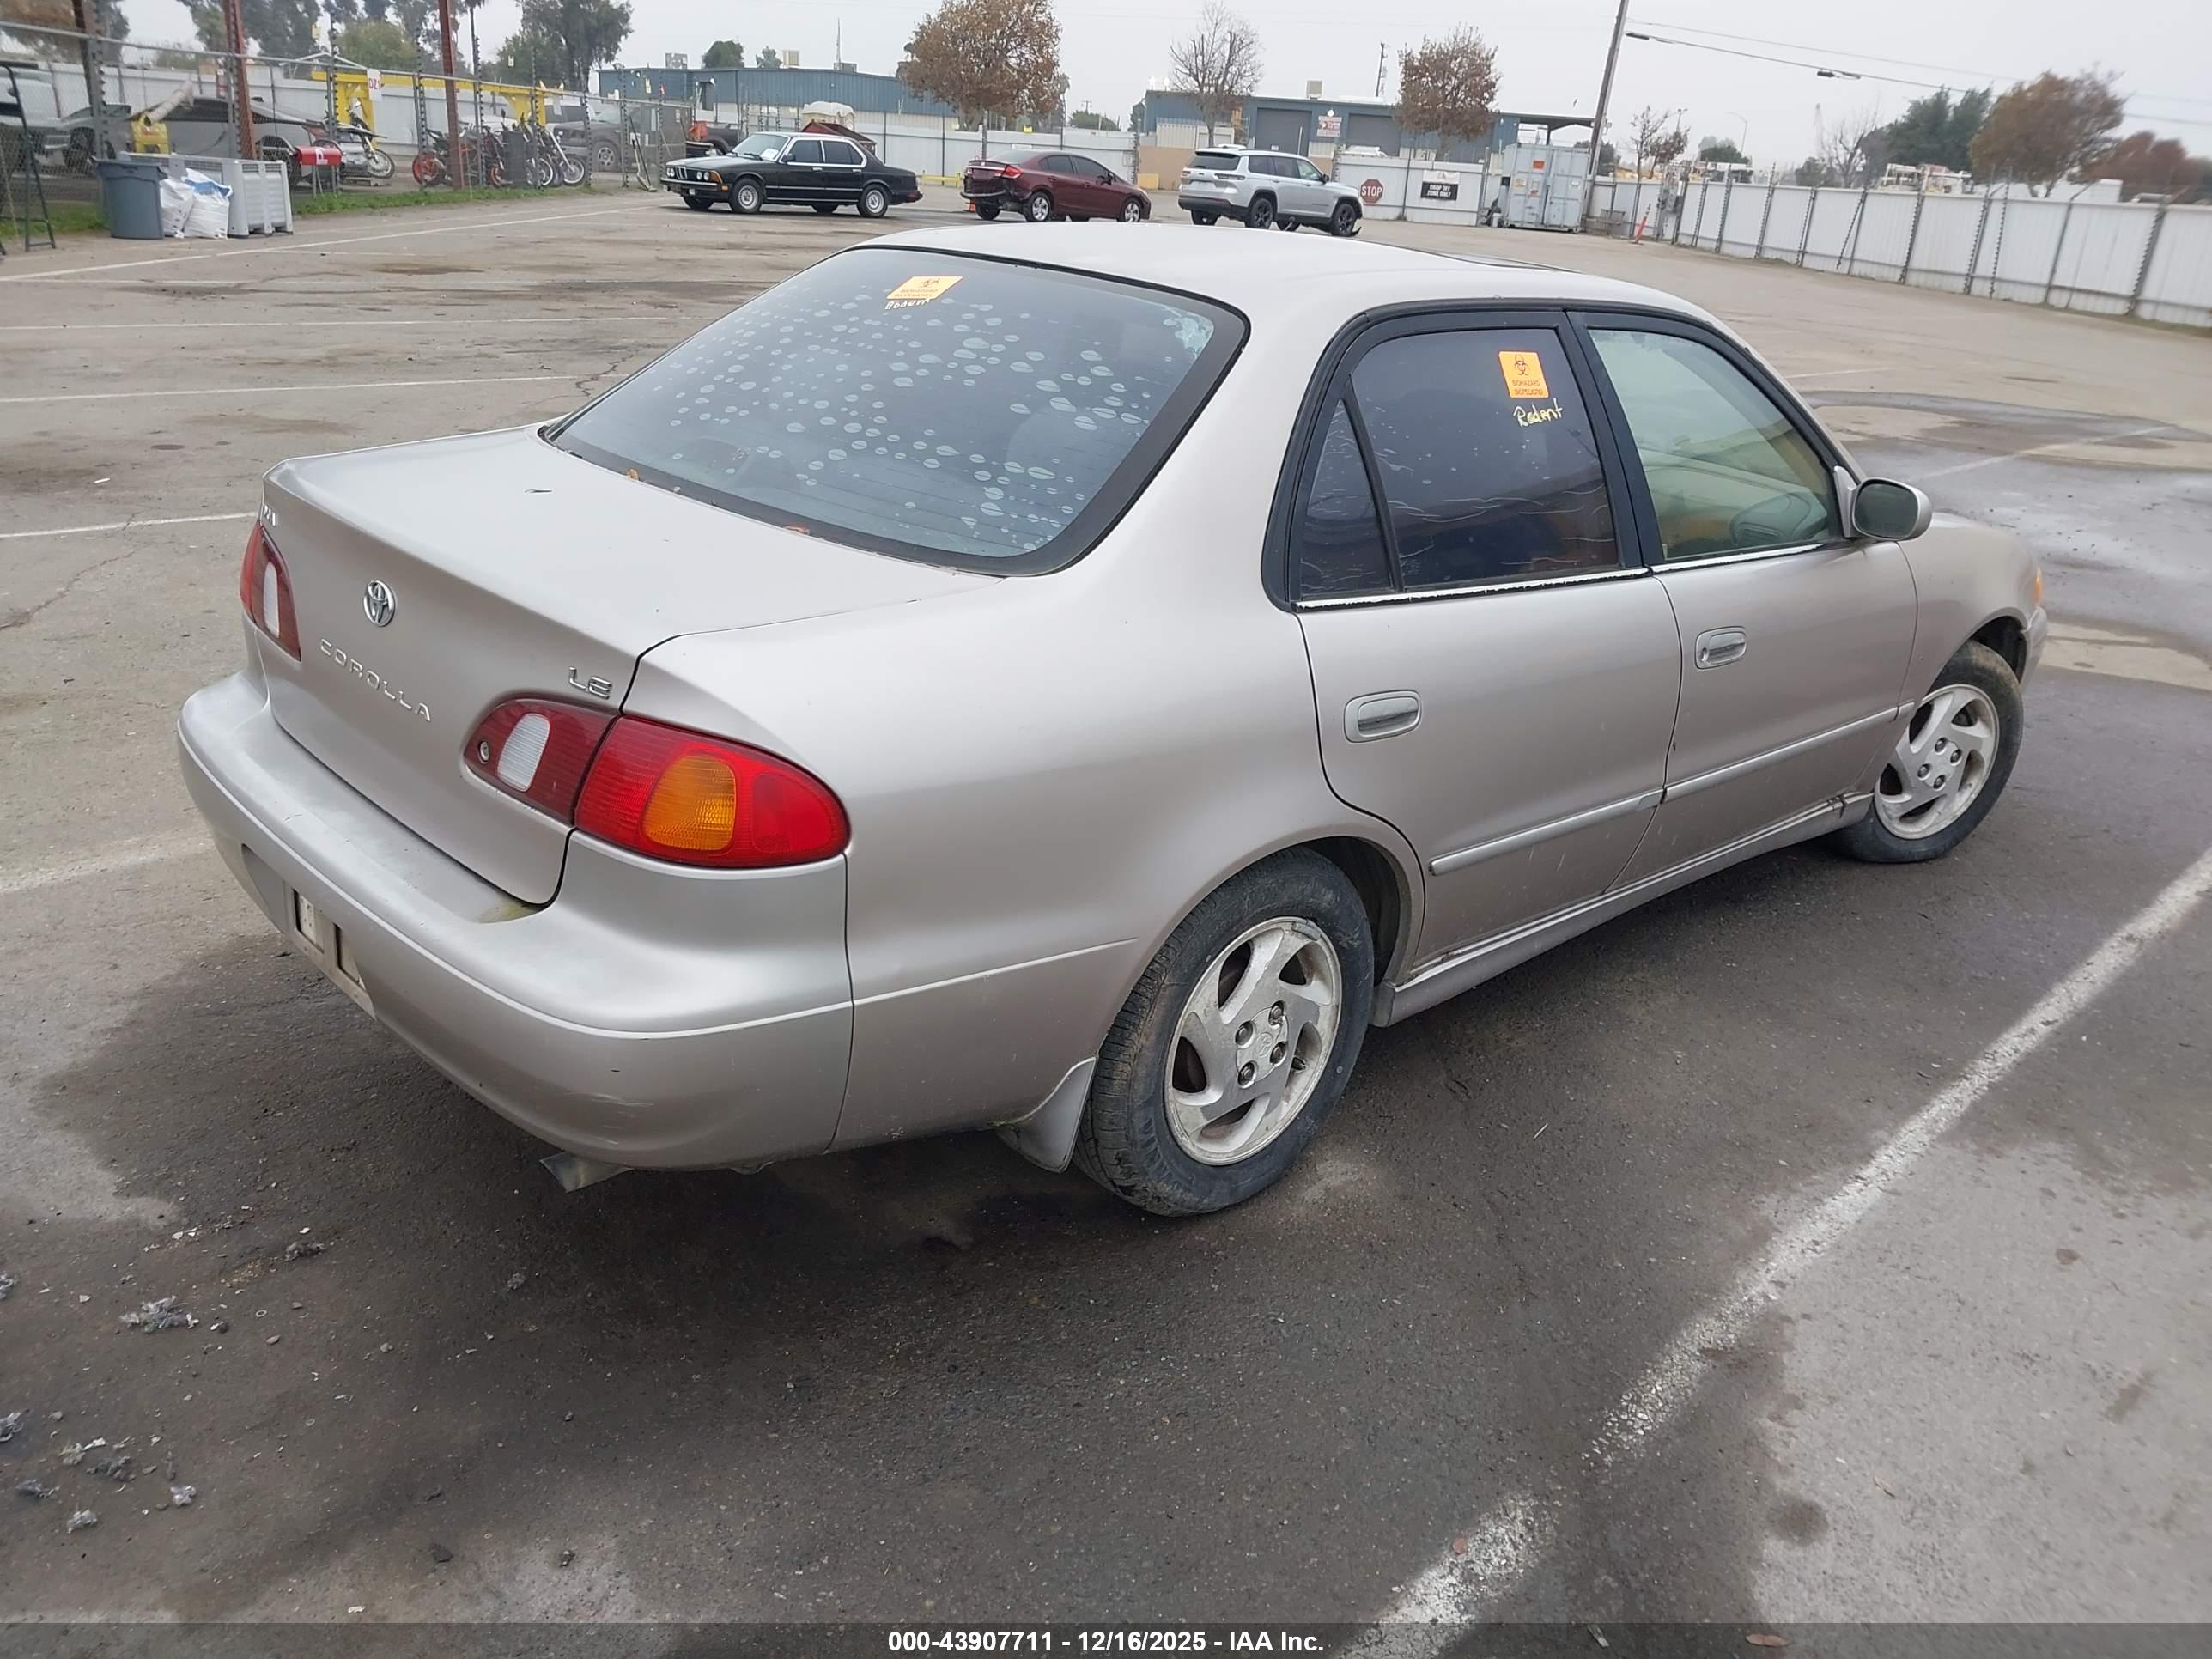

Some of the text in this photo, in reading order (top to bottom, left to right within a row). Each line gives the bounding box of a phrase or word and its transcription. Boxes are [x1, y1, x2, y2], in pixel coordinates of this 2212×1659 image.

[1361, 185, 1382, 198] STOP
[320, 638, 431, 722] COROLLA
[568, 666, 611, 699] LE
